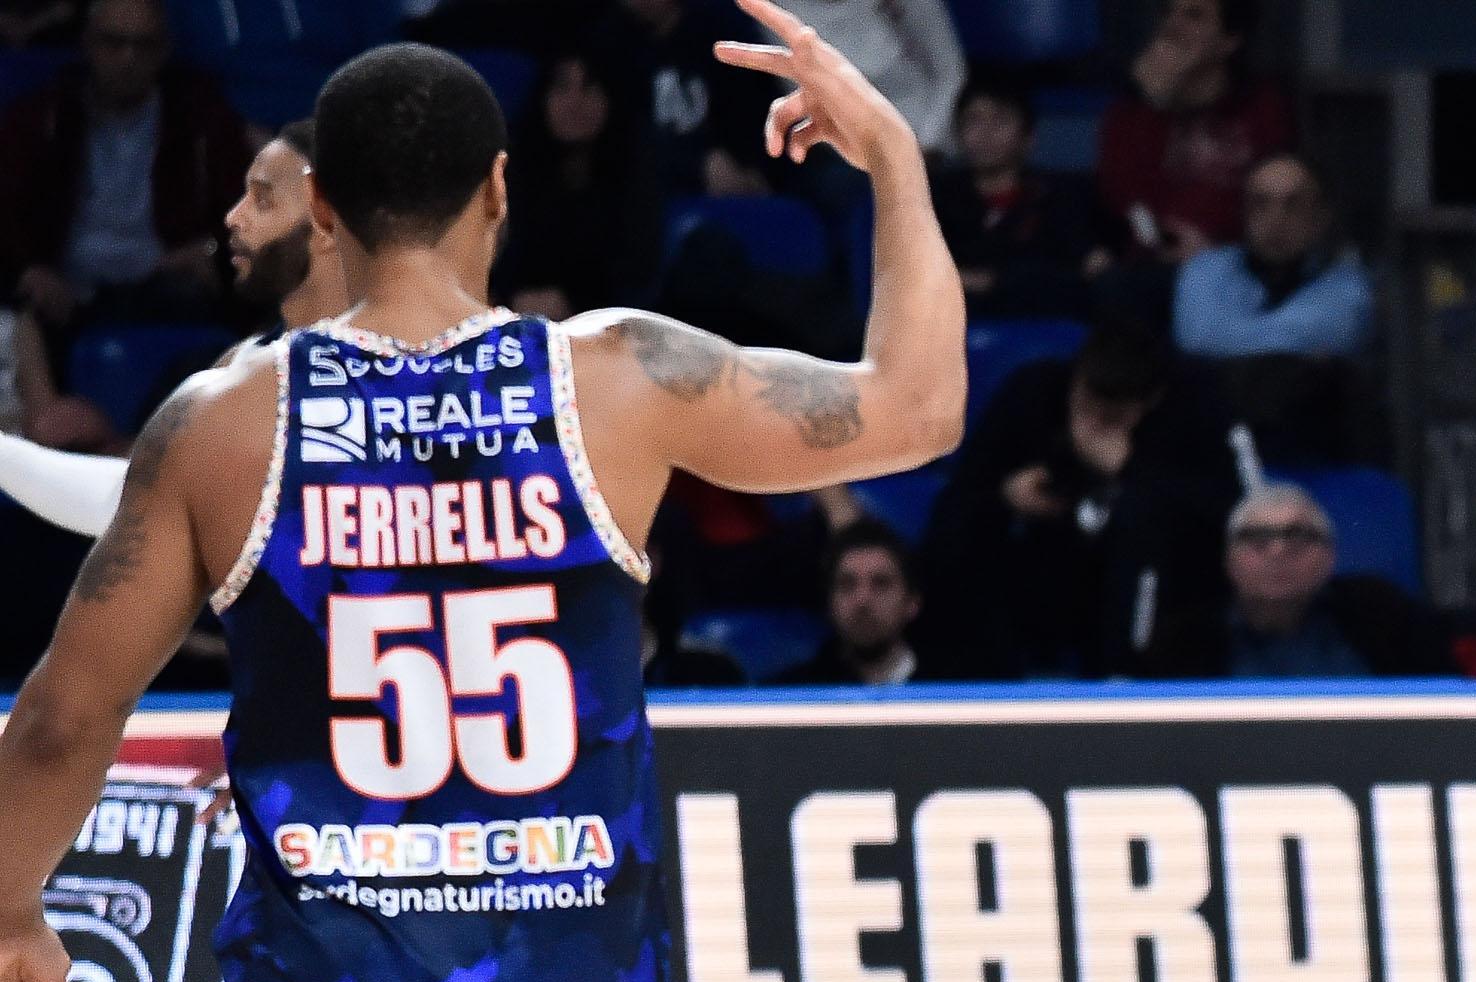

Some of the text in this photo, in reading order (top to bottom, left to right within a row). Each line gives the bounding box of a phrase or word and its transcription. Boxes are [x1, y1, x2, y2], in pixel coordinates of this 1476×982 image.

[372, 386, 538, 434] REALE
[374, 426, 540, 463] MUTUA
[300, 474, 567, 568] JERRELLS
[328, 583, 578, 800] 55
[273, 815, 616, 877] SARDEGNA
